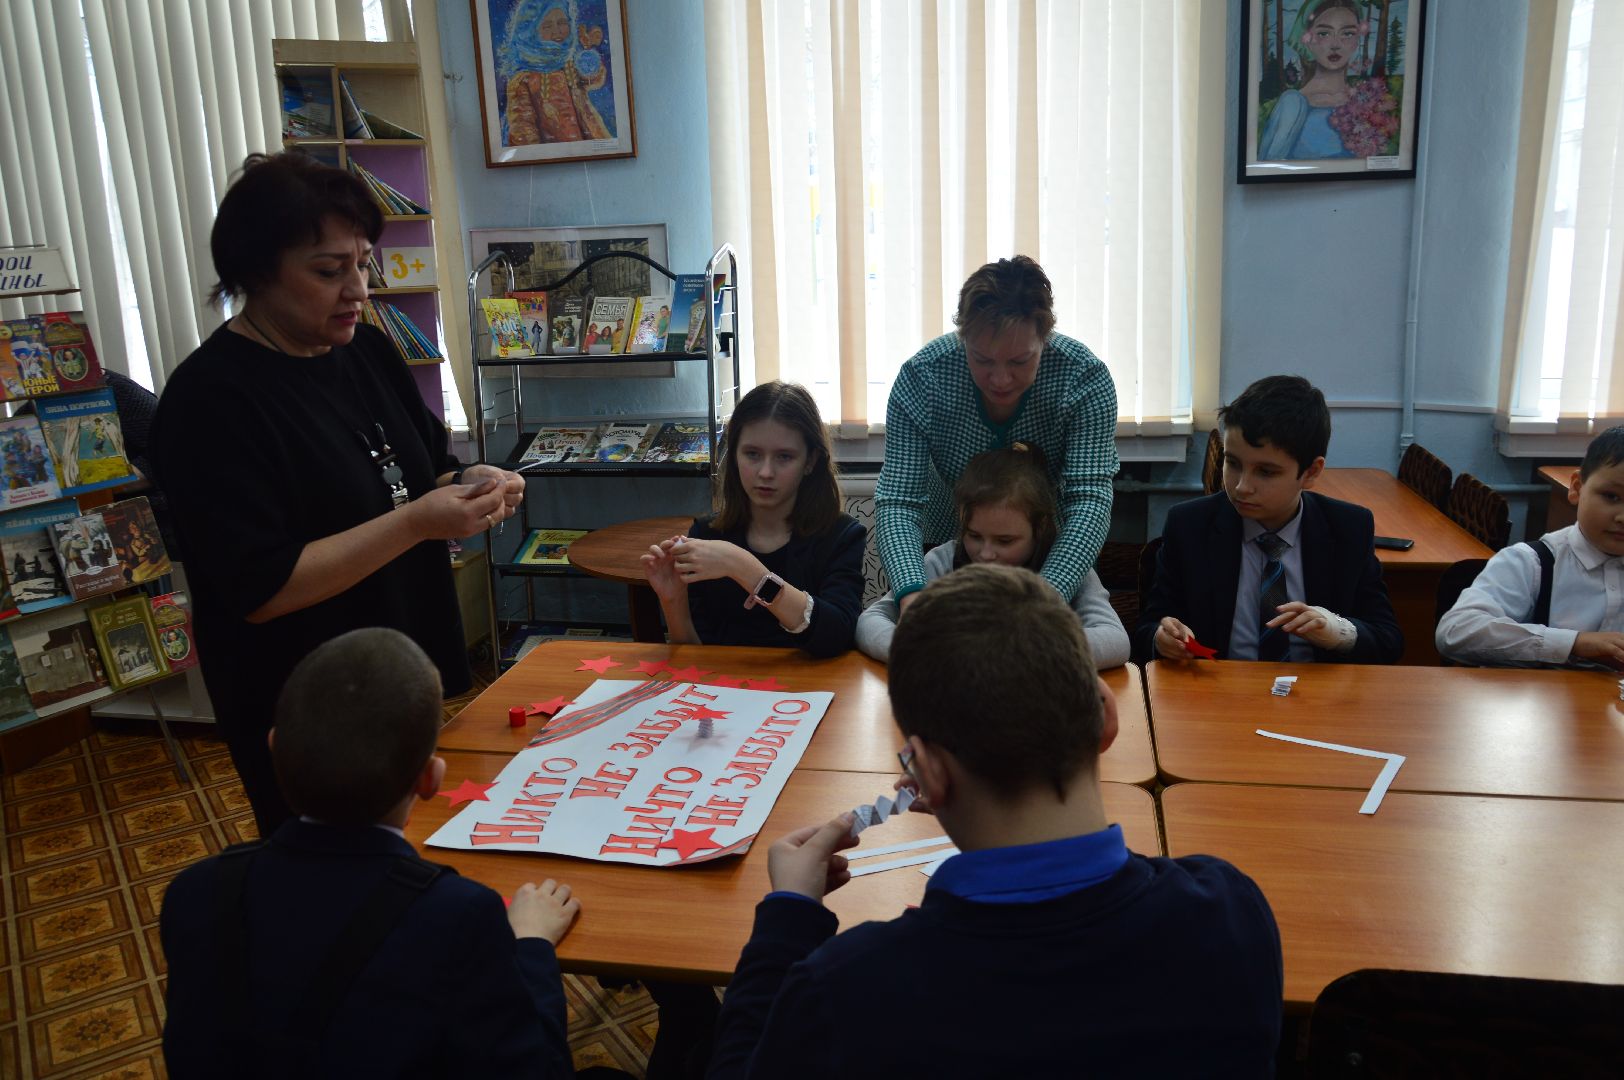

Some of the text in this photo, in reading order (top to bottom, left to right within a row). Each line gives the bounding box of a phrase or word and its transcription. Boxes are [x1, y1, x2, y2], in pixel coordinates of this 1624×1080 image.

[390, 253, 426, 280] 3+
[594, 303, 627, 316] СЕМЬЯ
[23, 375, 57, 388] ЮНЫЕ
[26, 384, 60, 395] ГЕРОИ
[570, 685, 719, 799] НЕ ЗАБЫТ
[686, 699, 812, 827] НЕ ЗАБЫТО
[470, 757, 578, 846] НИКТО
[600, 766, 702, 857] НИЧТО
